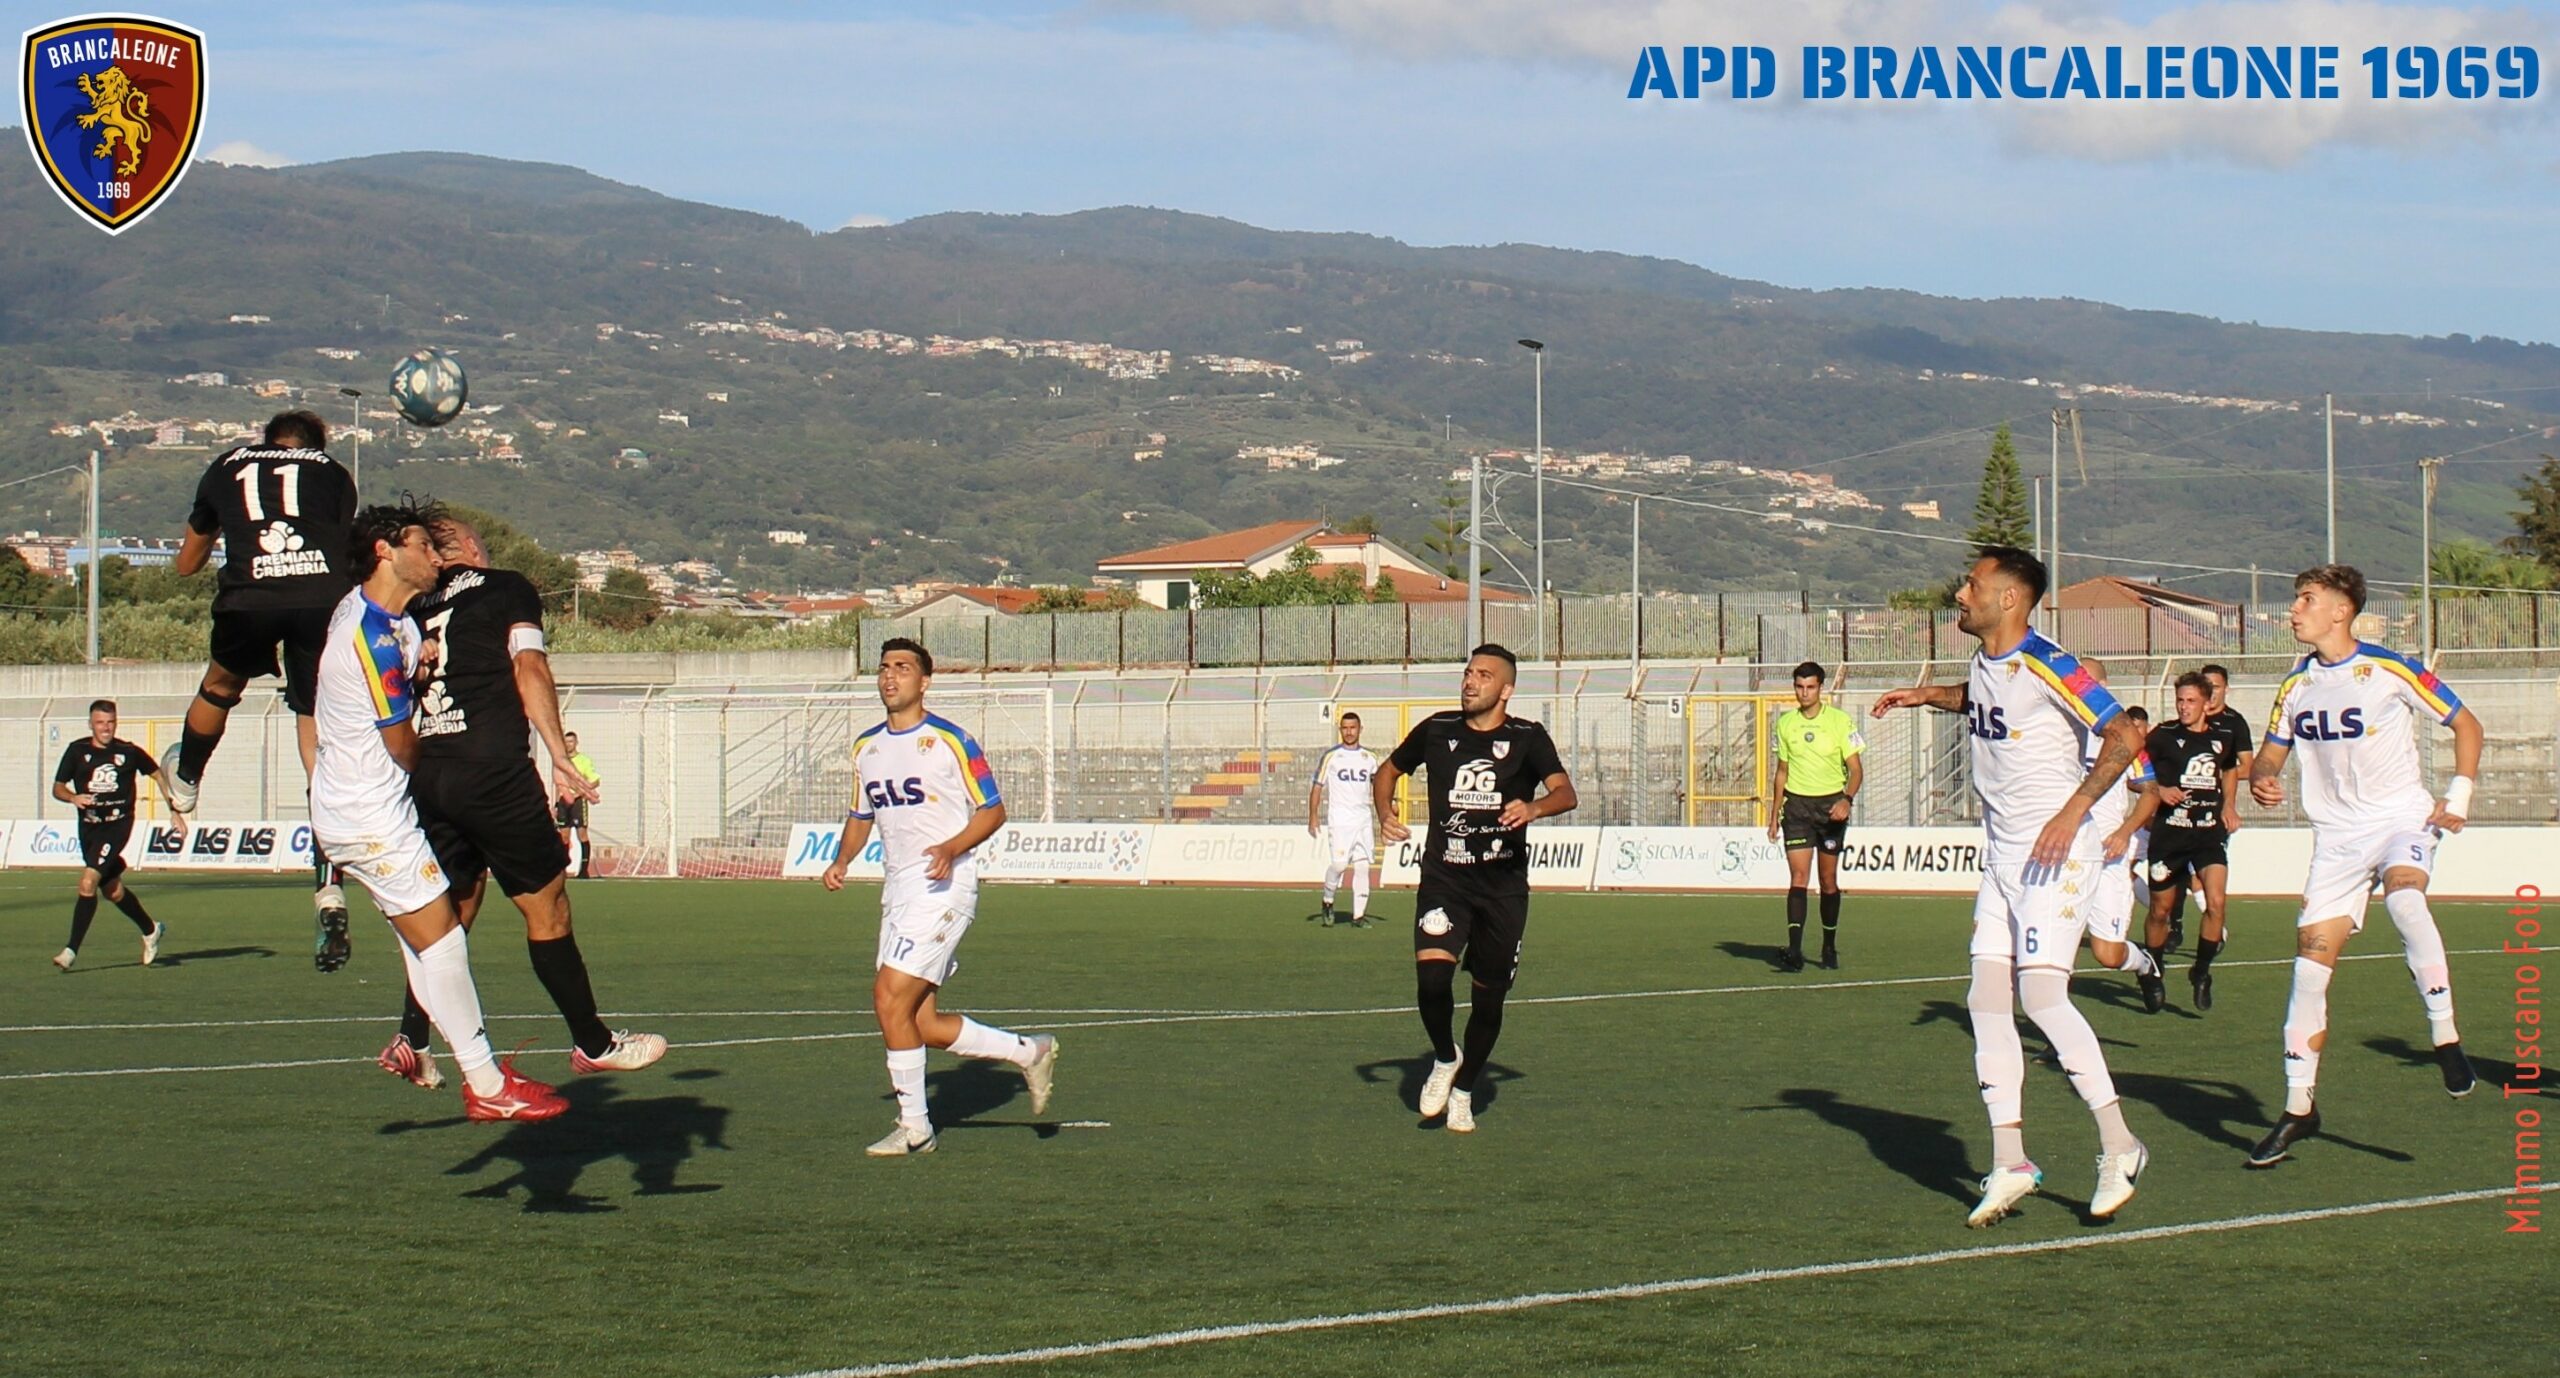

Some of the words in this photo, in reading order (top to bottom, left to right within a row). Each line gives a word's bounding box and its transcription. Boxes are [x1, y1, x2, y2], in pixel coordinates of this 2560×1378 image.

[235, 462, 300, 521] 11
[252, 549, 326, 569] PREMIATA
[252, 562, 330, 580] CREMERIA
[1322, 704, 1330, 719] 4
[1671, 698, 1680, 714] 5
[2294, 707, 2364, 741] GLS
[1337, 768, 1368, 782] GLS
[1454, 769, 1497, 792] DG
[865, 777, 925, 809] GLS
[1455, 793, 1496, 802] MOTORS
[101, 843, 111, 857] 9
[1004, 830, 1107, 853] Bernardi
[1646, 844, 1695, 861] SICMA
[1841, 845, 1895, 872] CASA
[2410, 844, 2423, 862] 5
[1001, 858, 1046, 870] Gelateria
[1049, 858, 1103, 872] Artigianale
[2111, 917, 2120, 936] 4
[893, 936, 915, 961] 17
[2025, 926, 2038, 954] 6
